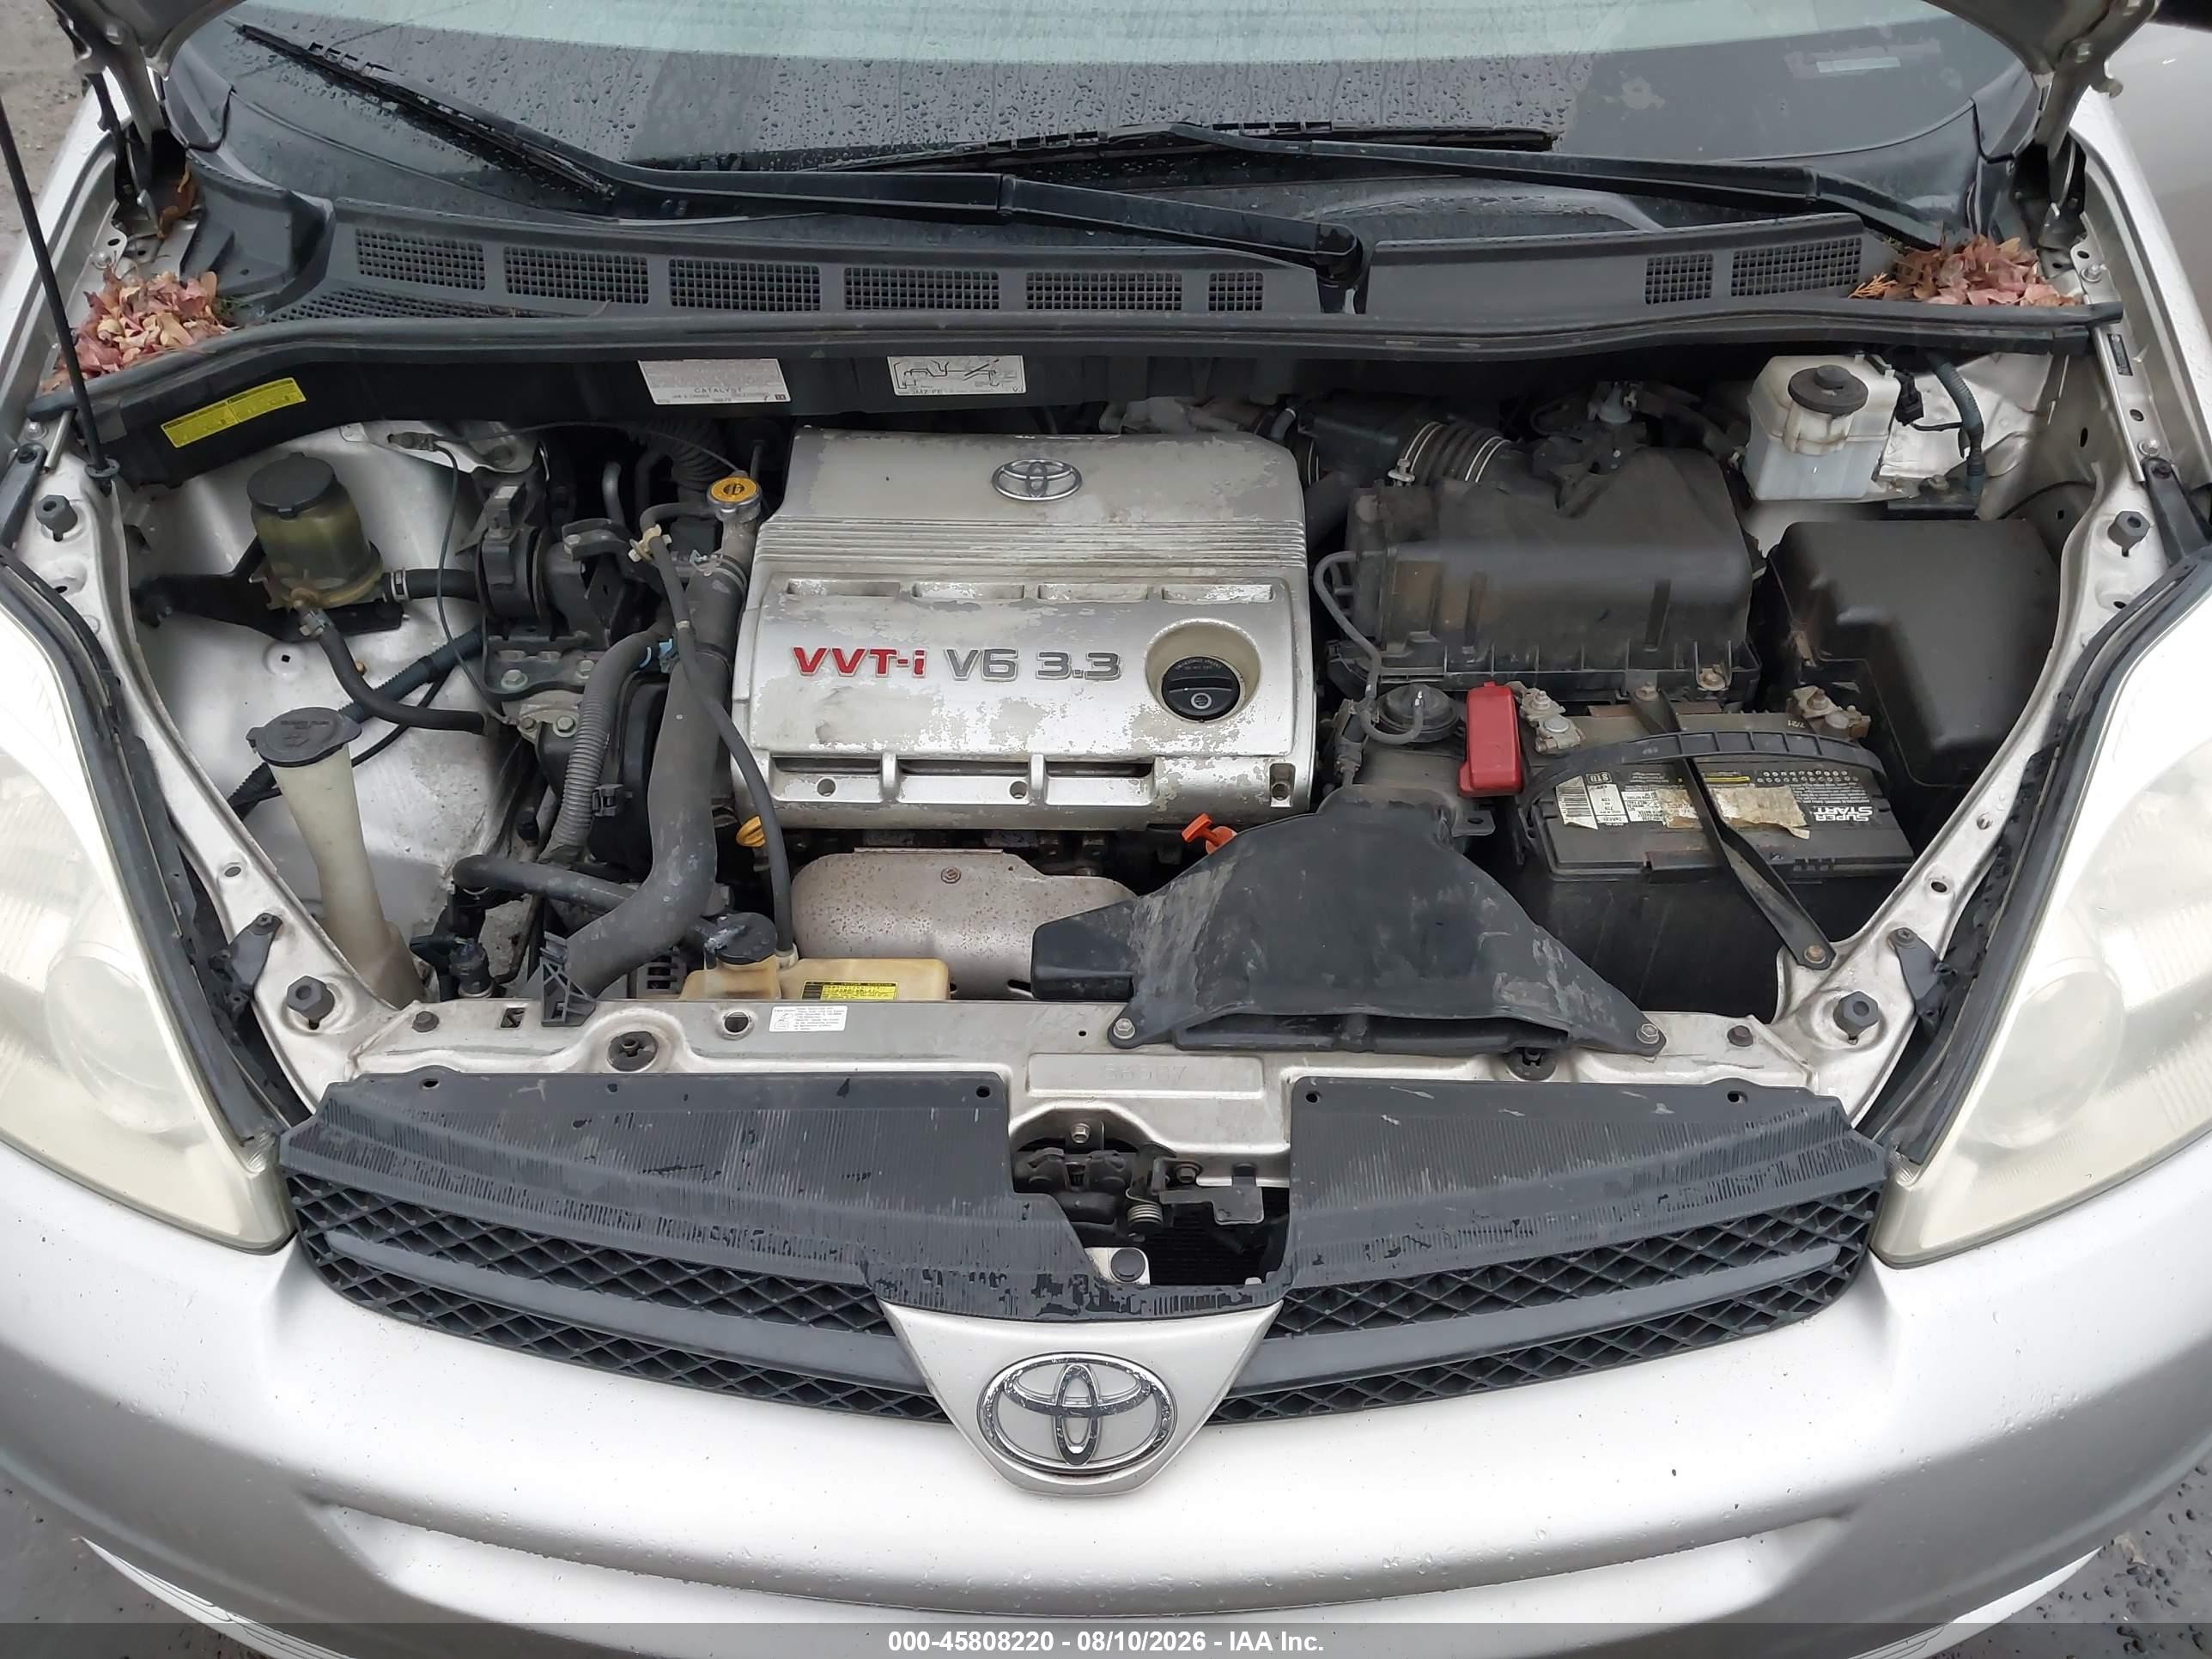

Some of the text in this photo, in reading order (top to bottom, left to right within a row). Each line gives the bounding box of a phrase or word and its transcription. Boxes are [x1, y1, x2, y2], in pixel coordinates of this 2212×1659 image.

[793, 647, 1124, 681] VVT-i V6 3.3
[1814, 806, 1873, 817] START
